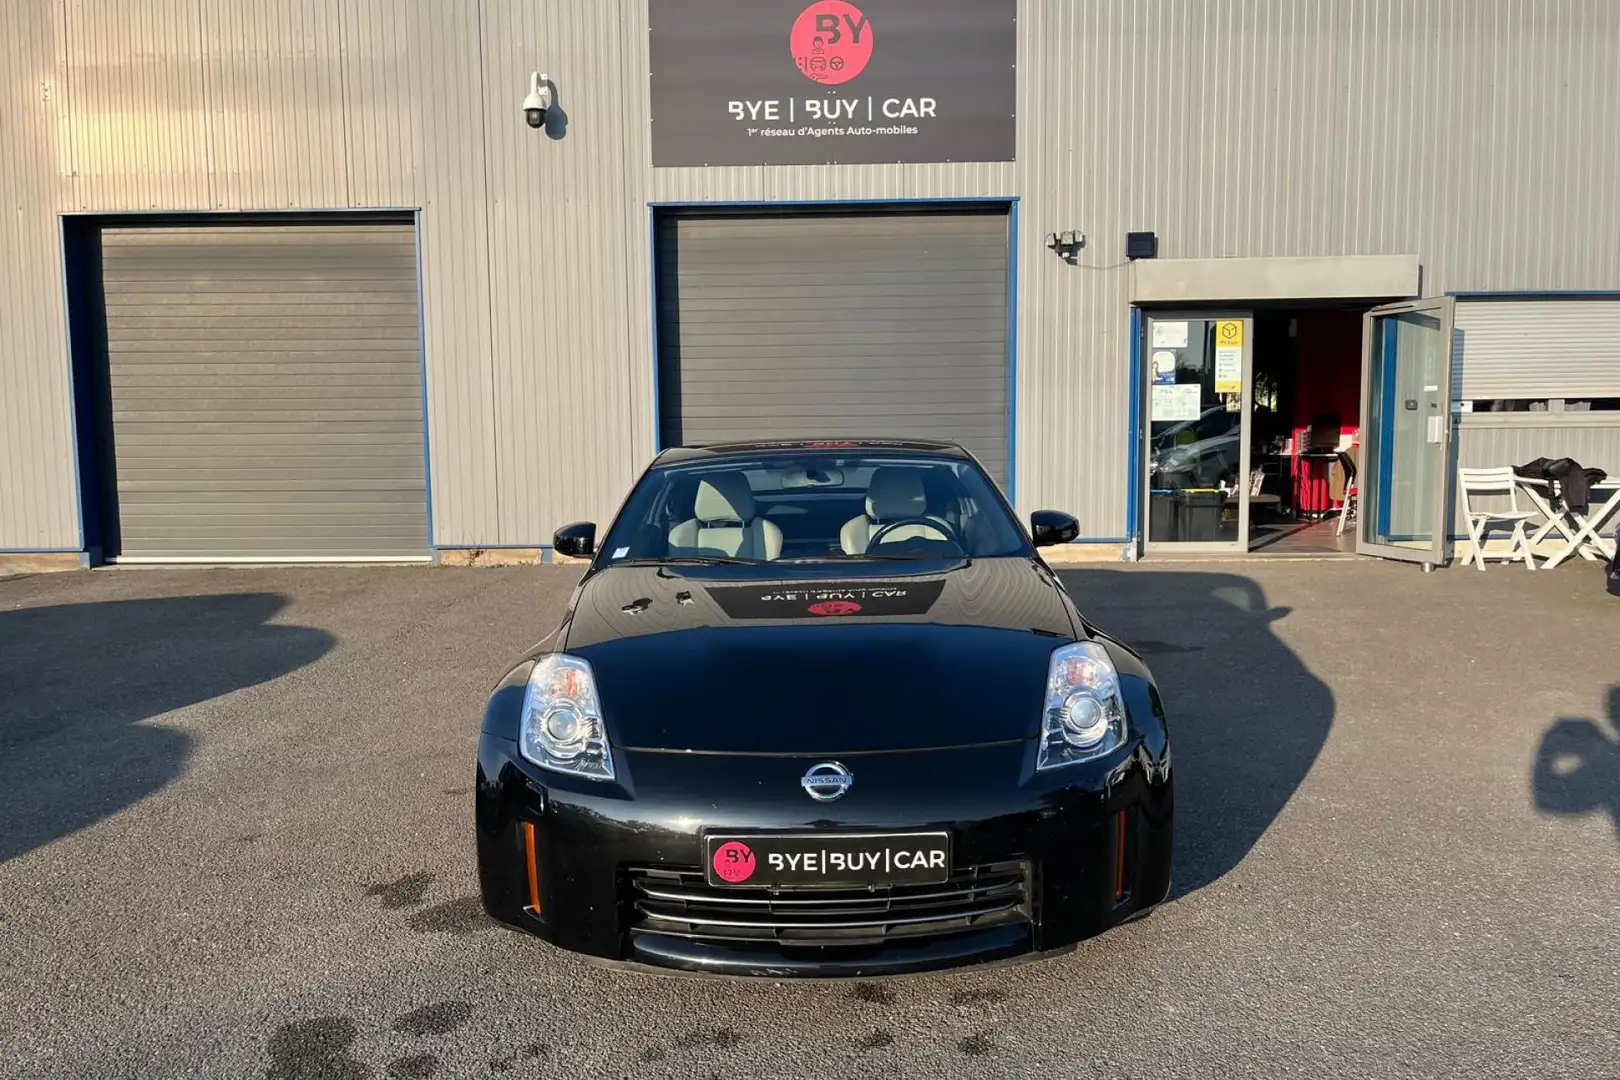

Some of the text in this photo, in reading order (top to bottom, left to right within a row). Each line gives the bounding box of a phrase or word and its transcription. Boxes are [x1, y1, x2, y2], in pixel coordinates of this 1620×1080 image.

[815, 13, 869, 45] BY
[728, 97, 937, 121] BYE BUY CAR
[760, 127, 795, 137] réseau
[797, 125, 845, 138] d'Agents
[846, 124, 918, 135] Auto-mobiles
[726, 849, 752, 863] BY
[768, 850, 945, 871] BYE BUY CAR
